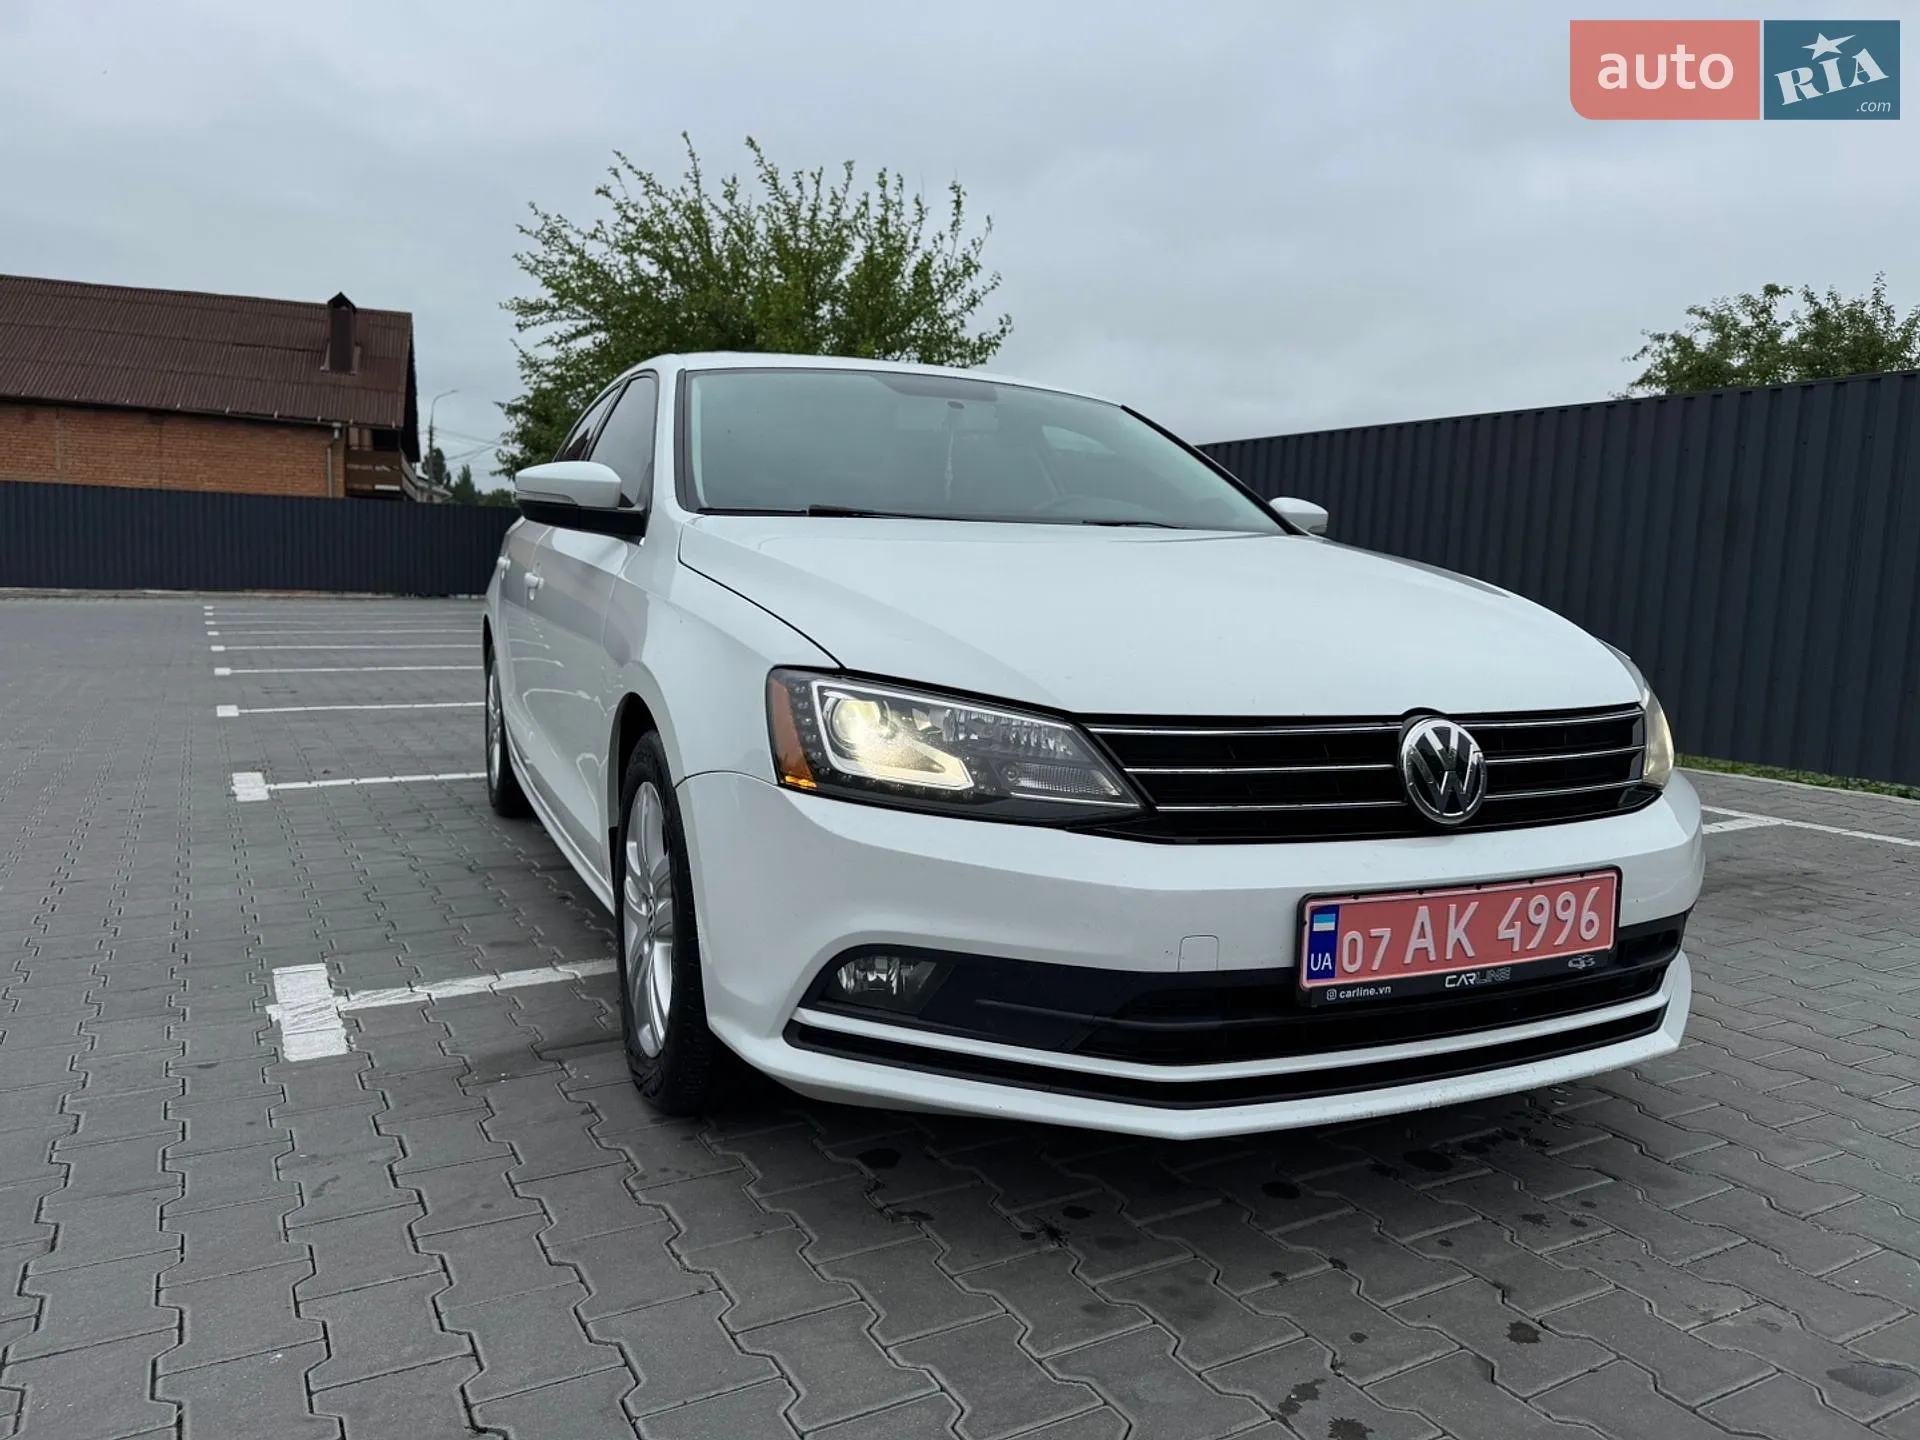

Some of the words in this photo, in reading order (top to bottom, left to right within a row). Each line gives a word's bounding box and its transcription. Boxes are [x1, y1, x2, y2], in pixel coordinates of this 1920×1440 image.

[1341, 928, 1392, 973] 07
[1403, 901, 1480, 965] AK
[1497, 886, 1600, 952] 4996
[1310, 952, 1333, 971] UA
[1339, 986, 1392, 999] carline.vn
